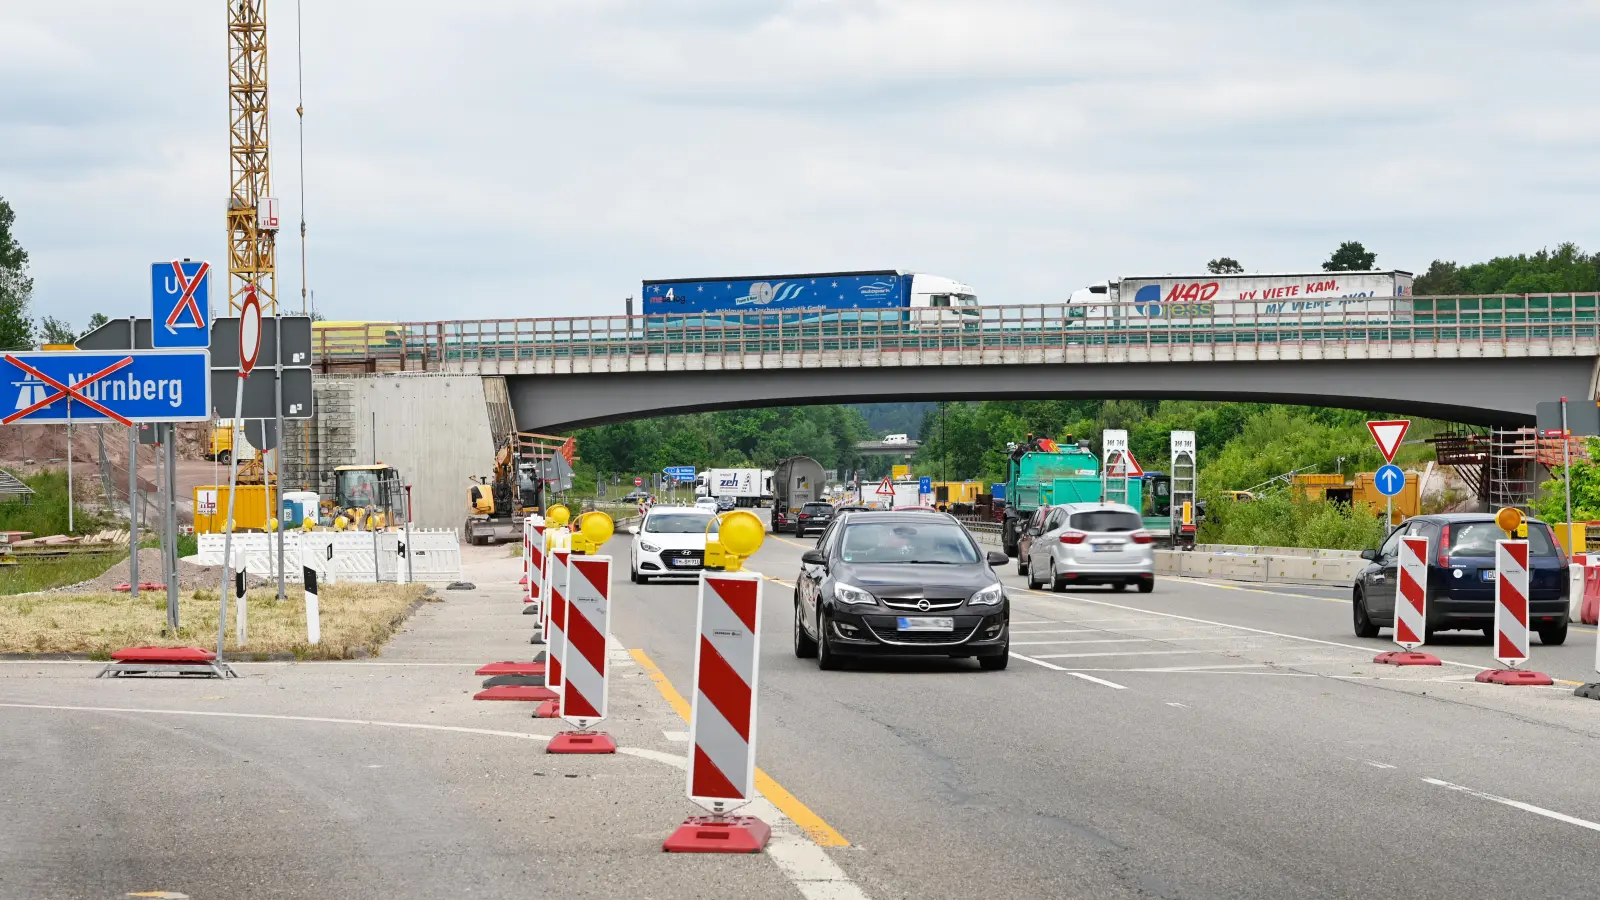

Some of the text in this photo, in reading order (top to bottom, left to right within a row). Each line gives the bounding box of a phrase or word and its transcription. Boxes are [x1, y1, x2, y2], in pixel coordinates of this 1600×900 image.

[1164, 282, 1219, 302] NAD
[1262, 285, 1300, 299] VIETE
[1306, 280, 1341, 295] KAM,
[1265, 303, 1287, 314] MY
[720, 473, 738, 486] zeh
